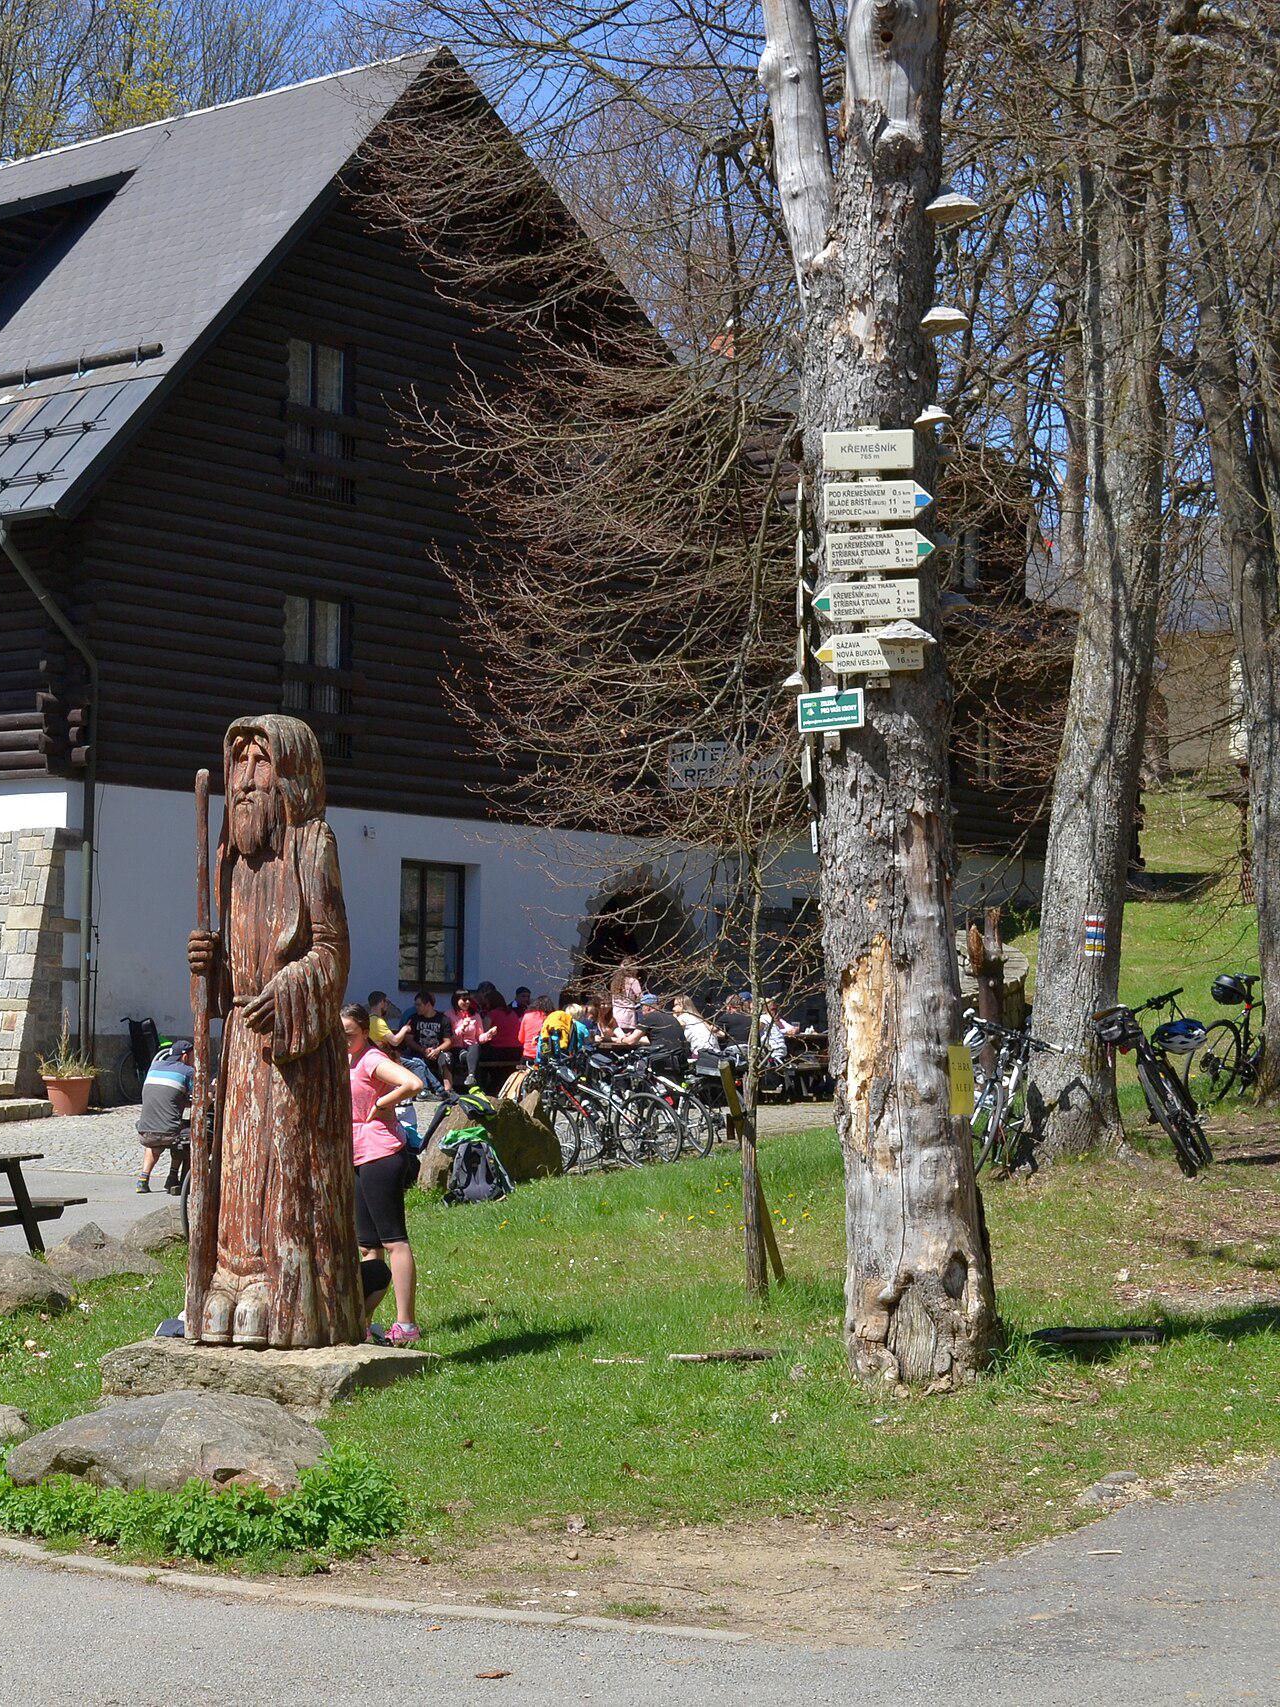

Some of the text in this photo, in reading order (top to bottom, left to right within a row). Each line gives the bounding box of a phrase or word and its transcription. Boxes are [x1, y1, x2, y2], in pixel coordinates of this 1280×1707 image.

[841, 443, 896, 453] KŘEMEŠNÍK
[844, 541, 884, 549] KŘEMEŠNÍKEM
[833, 591, 864, 599] KŘEMEŠNÍK
[837, 650, 854, 658] NOVÁ
